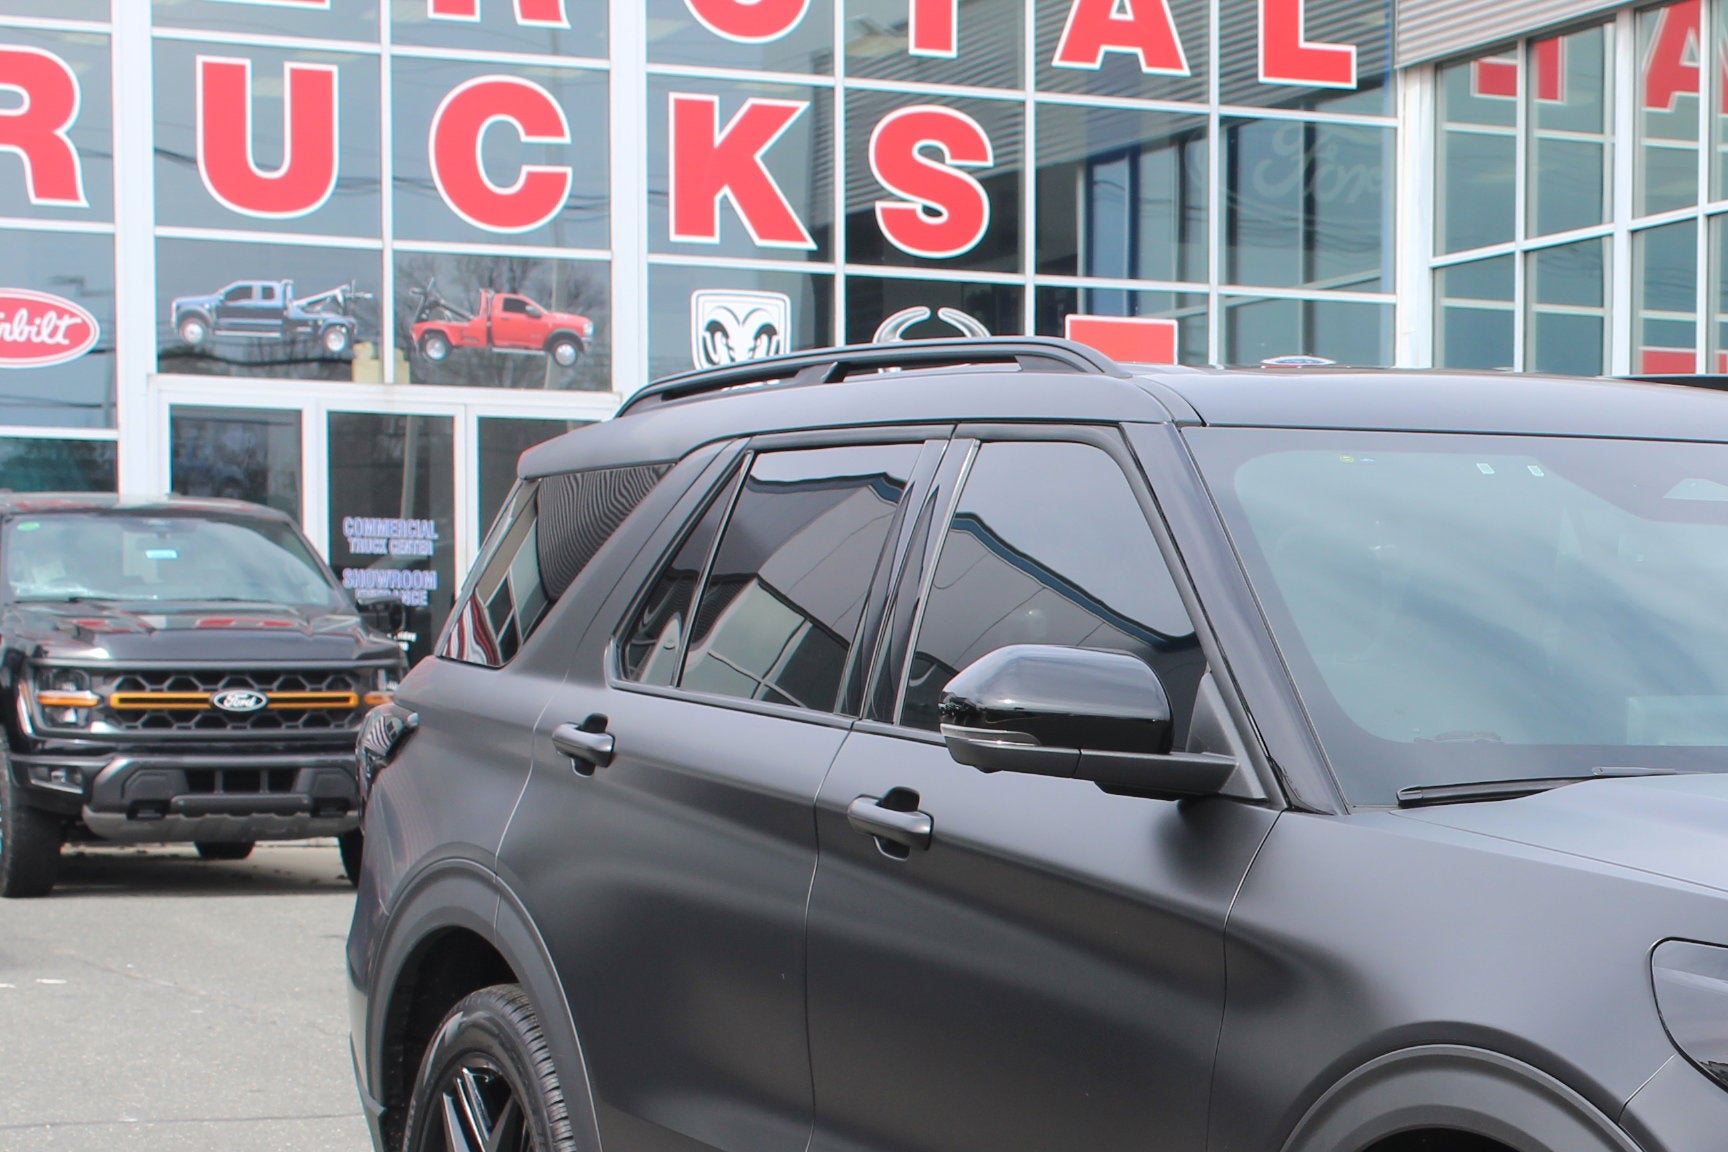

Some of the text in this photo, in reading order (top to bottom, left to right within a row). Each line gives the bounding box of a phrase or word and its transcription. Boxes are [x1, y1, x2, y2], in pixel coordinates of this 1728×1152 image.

[342, 517, 439, 540] COMMERCIAL
[347, 537, 388, 554] TRUCK
[342, 568, 438, 590] SHOWROOM
